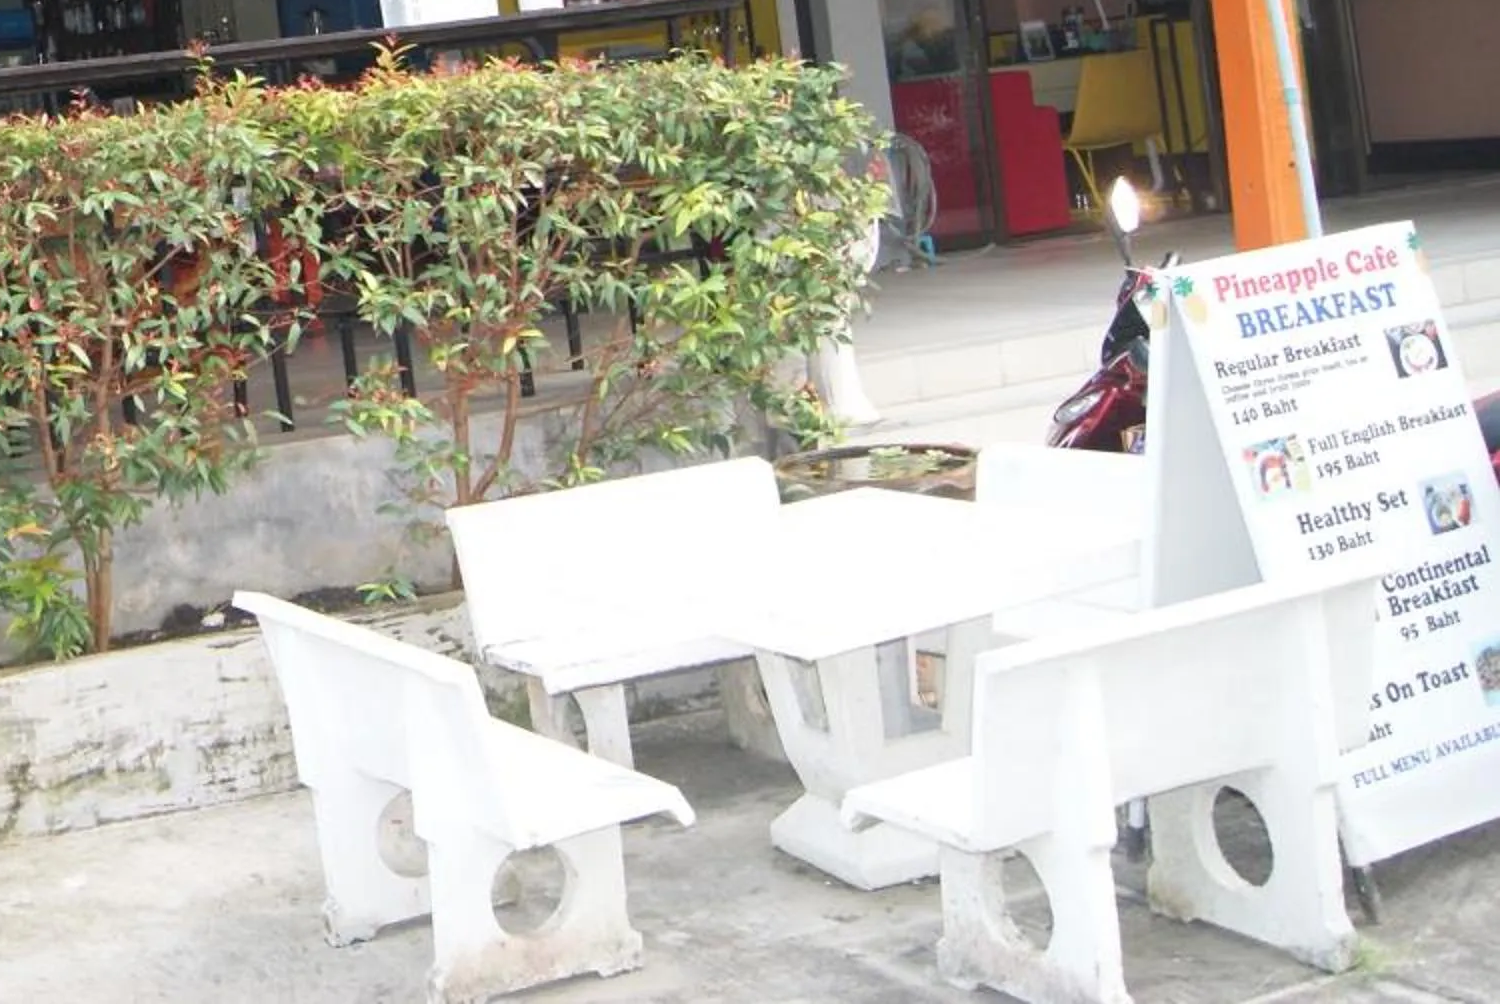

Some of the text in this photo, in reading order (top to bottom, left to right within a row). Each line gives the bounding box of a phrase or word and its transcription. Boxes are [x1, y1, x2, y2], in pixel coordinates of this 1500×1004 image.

[1212, 245, 1399, 303] Pineapple Cafe
[1235, 282, 1397, 339] BREAKFAST
[1214, 353, 1280, 379] Regular
[1283, 334, 1362, 364] Breakfast
[1232, 397, 1299, 425] 140 Baht
[1307, 402, 1468, 455] Full English Breakfast
[1316, 449, 1381, 479] 195 Baht
[1296, 489, 1409, 535] Healthy Set
[1308, 531, 1374, 562] 130 Baht
[1381, 543, 1491, 593] Continental
[1387, 574, 1480, 617] Breakfast
[1400, 611, 1461, 642] 95 Baht
[1385, 681, 1415, 703] On
[1416, 661, 1469, 692] Toast
[1352, 764, 1390, 788] FULL
[1390, 747, 1432, 774] MENU
